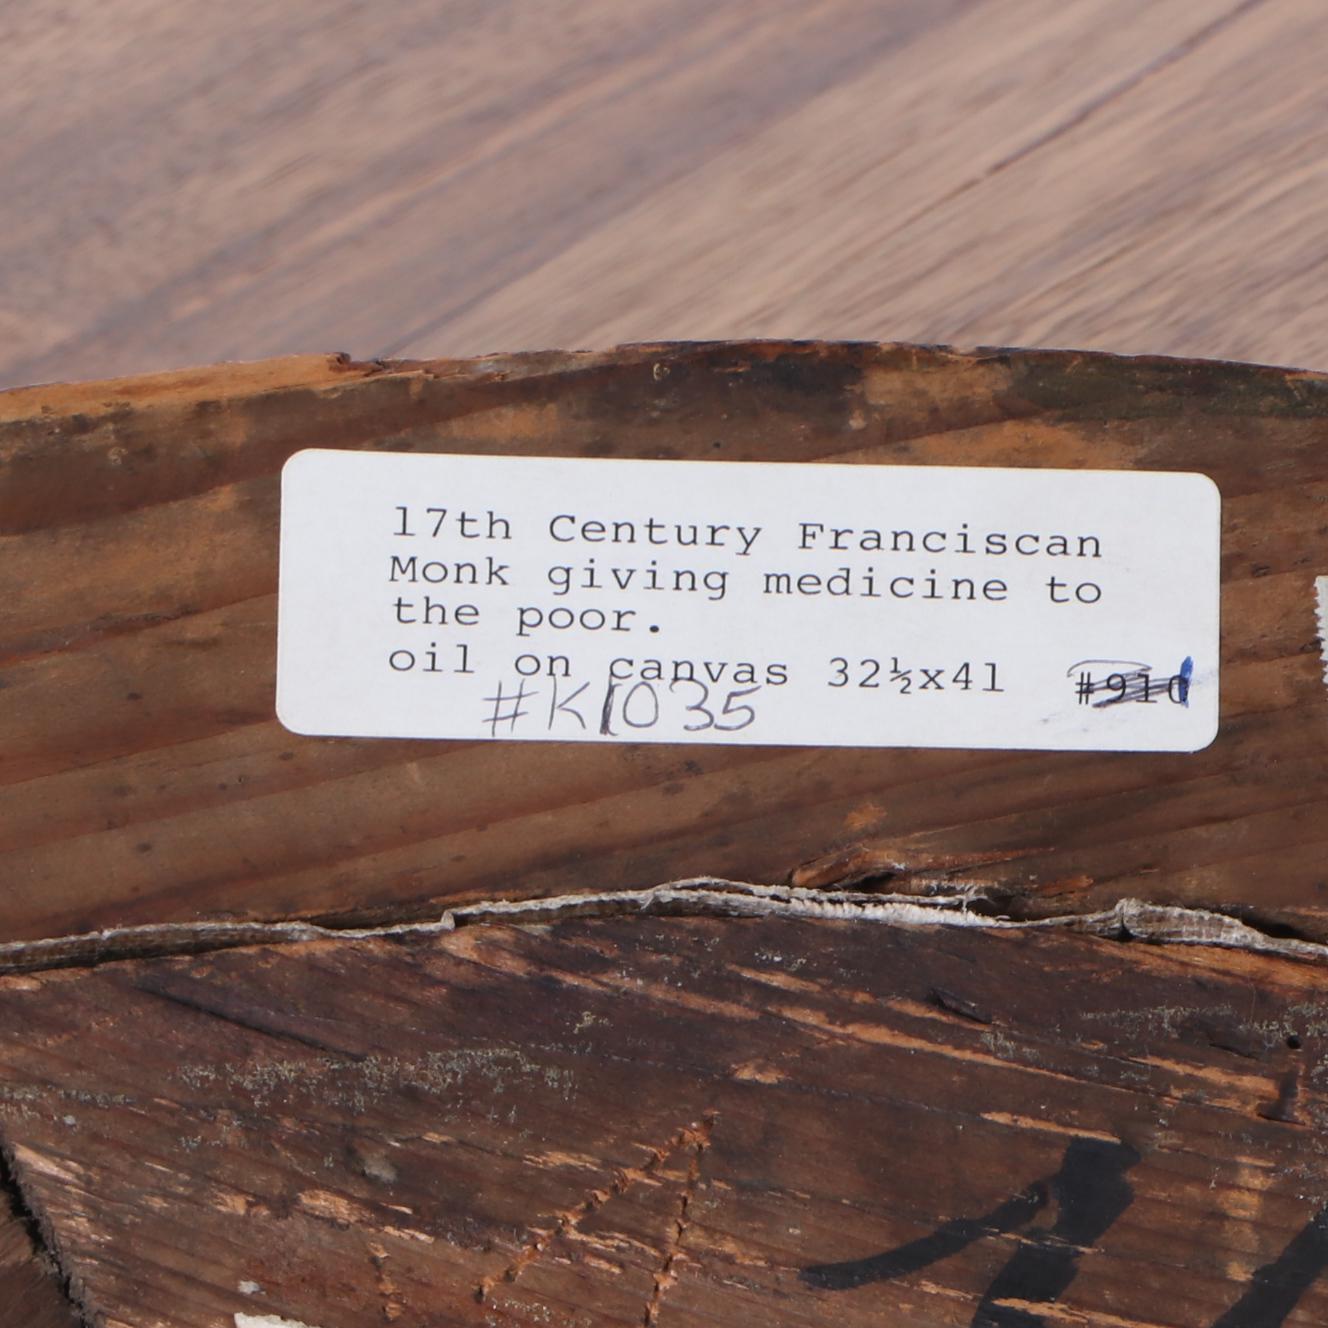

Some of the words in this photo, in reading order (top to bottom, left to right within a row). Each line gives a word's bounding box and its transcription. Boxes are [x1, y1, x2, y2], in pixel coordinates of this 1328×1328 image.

[548, 513, 763, 556] Century
[797, 522, 1103, 558] Franciscan
[388, 556, 510, 586] Monk
[547, 559, 729, 600] giving
[763, 567, 1009, 601] medicine
[1045, 575, 1103, 605] to
[392, 595, 481, 626] the
[515, 606, 661, 637] poor.
[388, 643, 476, 674] oil
[514, 654, 572, 677] on
[608, 656, 790, 685] canvas
